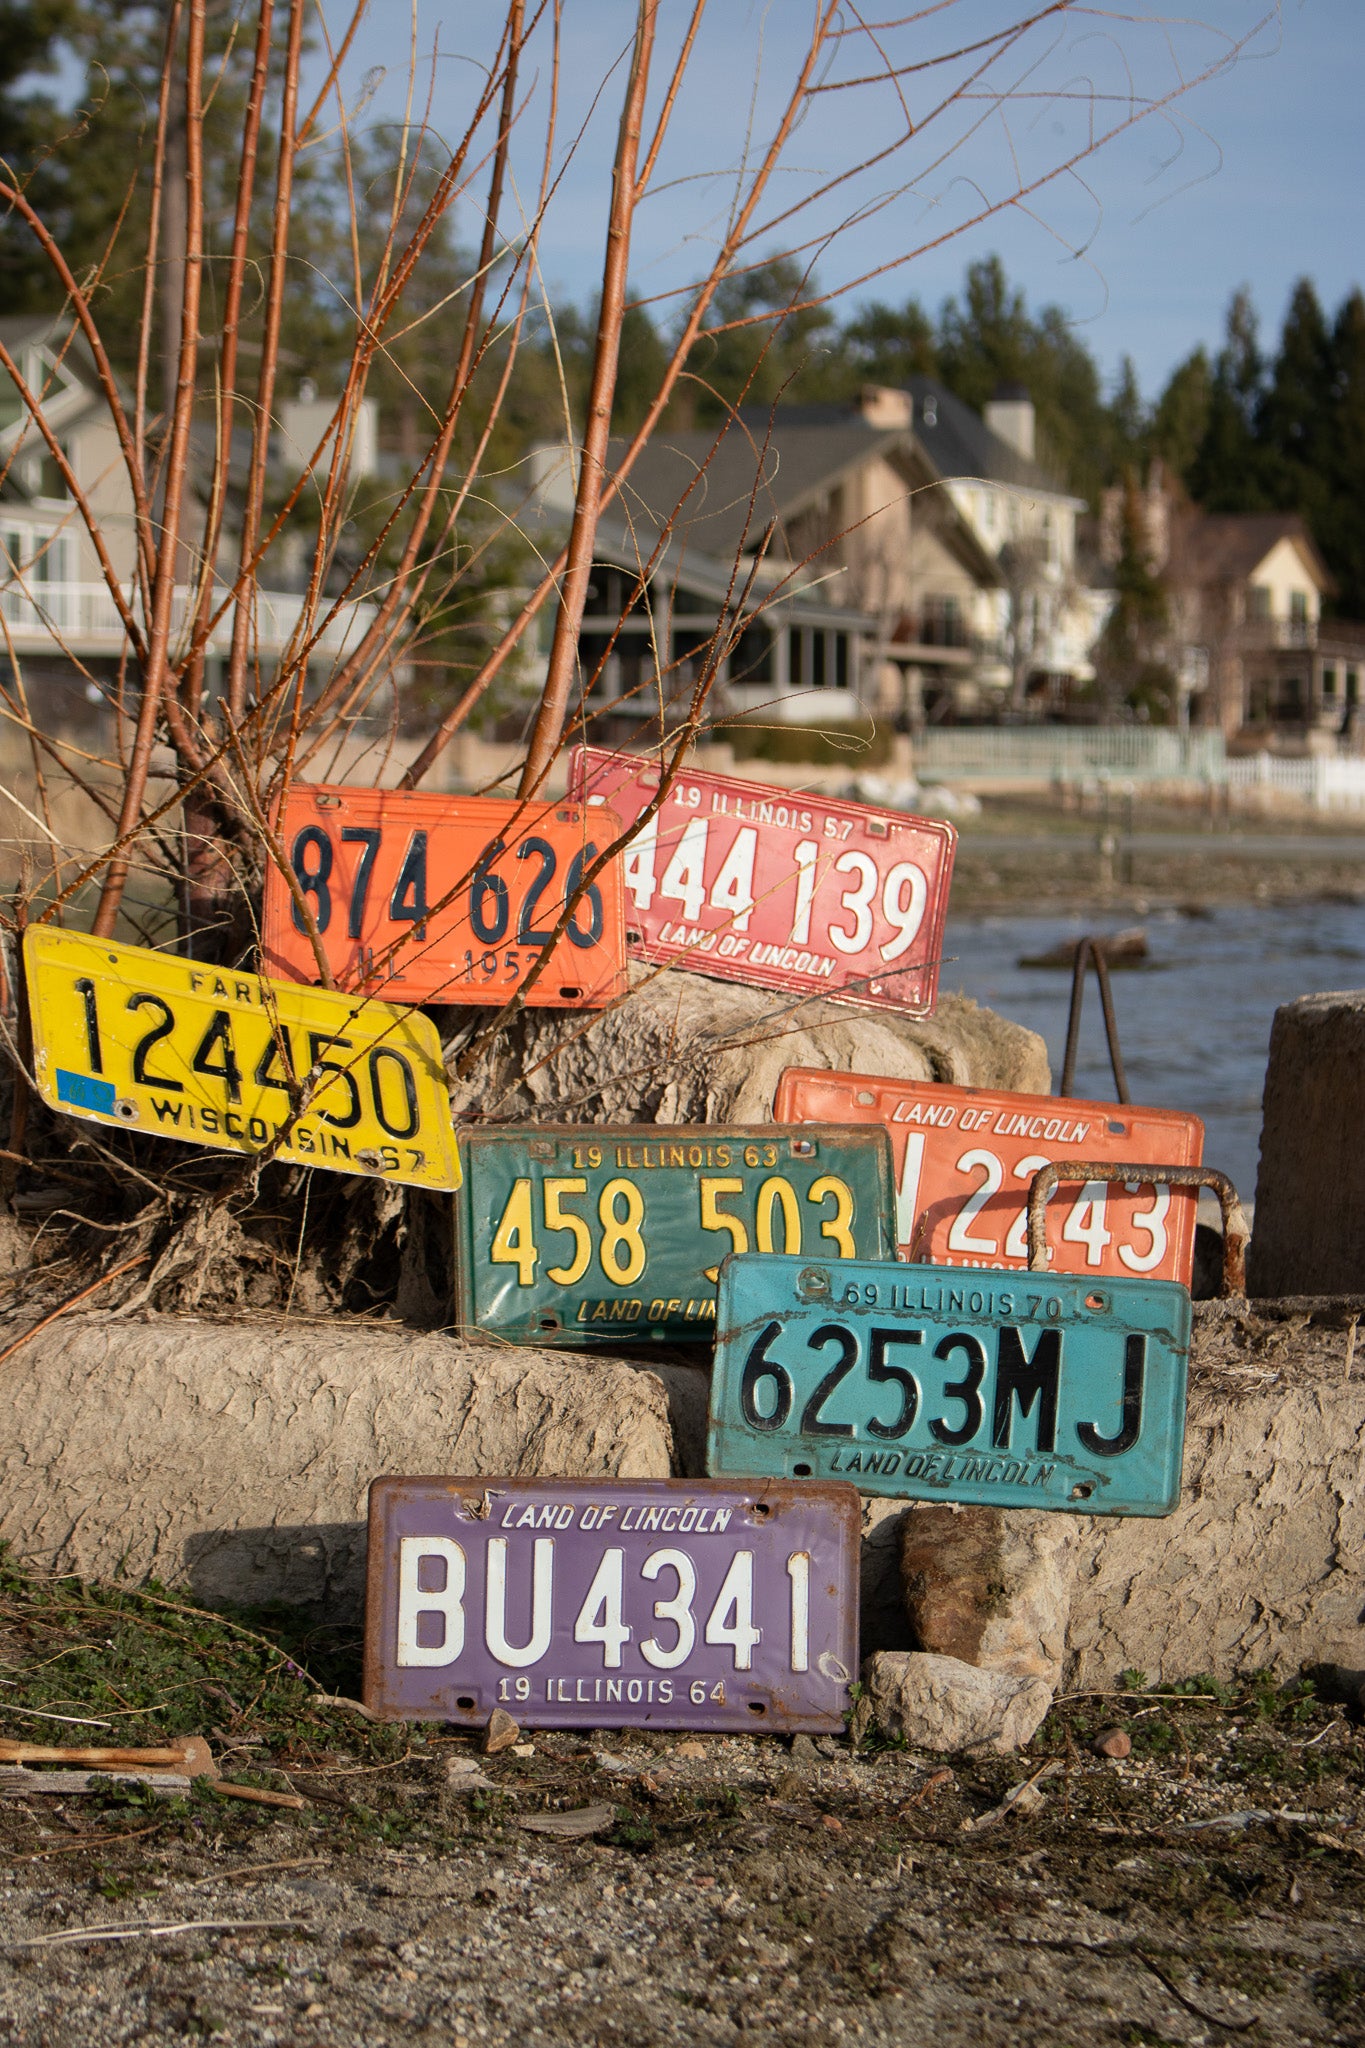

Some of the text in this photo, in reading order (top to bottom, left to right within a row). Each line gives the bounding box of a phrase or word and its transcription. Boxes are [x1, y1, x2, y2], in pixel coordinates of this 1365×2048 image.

[674, 784, 854, 841] 19 ILLINOIS 57
[291, 825, 605, 949] 874 626
[586, 794, 928, 962] 444 139
[659, 922, 837, 977] LAND OF LINCOLN
[75, 976, 420, 1141] 124450
[892, 1101, 1090, 1143] LAND OF LINCOLN
[573, 1145, 778, 1168] 19 ILLINOIS 63
[490, 1175, 856, 1286] 458 503
[577, 1298, 643, 1322] LAND
[647, 1298, 682, 1322] OF
[845, 1283, 1063, 1319] 69 ILLINOIS 70
[741, 1320, 1150, 1457] 6253MJ
[831, 1450, 1057, 1487] LAND OF LINCOLN
[501, 1503, 734, 1533] LAND OF LINCOLN
[498, 1676, 726, 1706] 19 ILLINOIS 64
